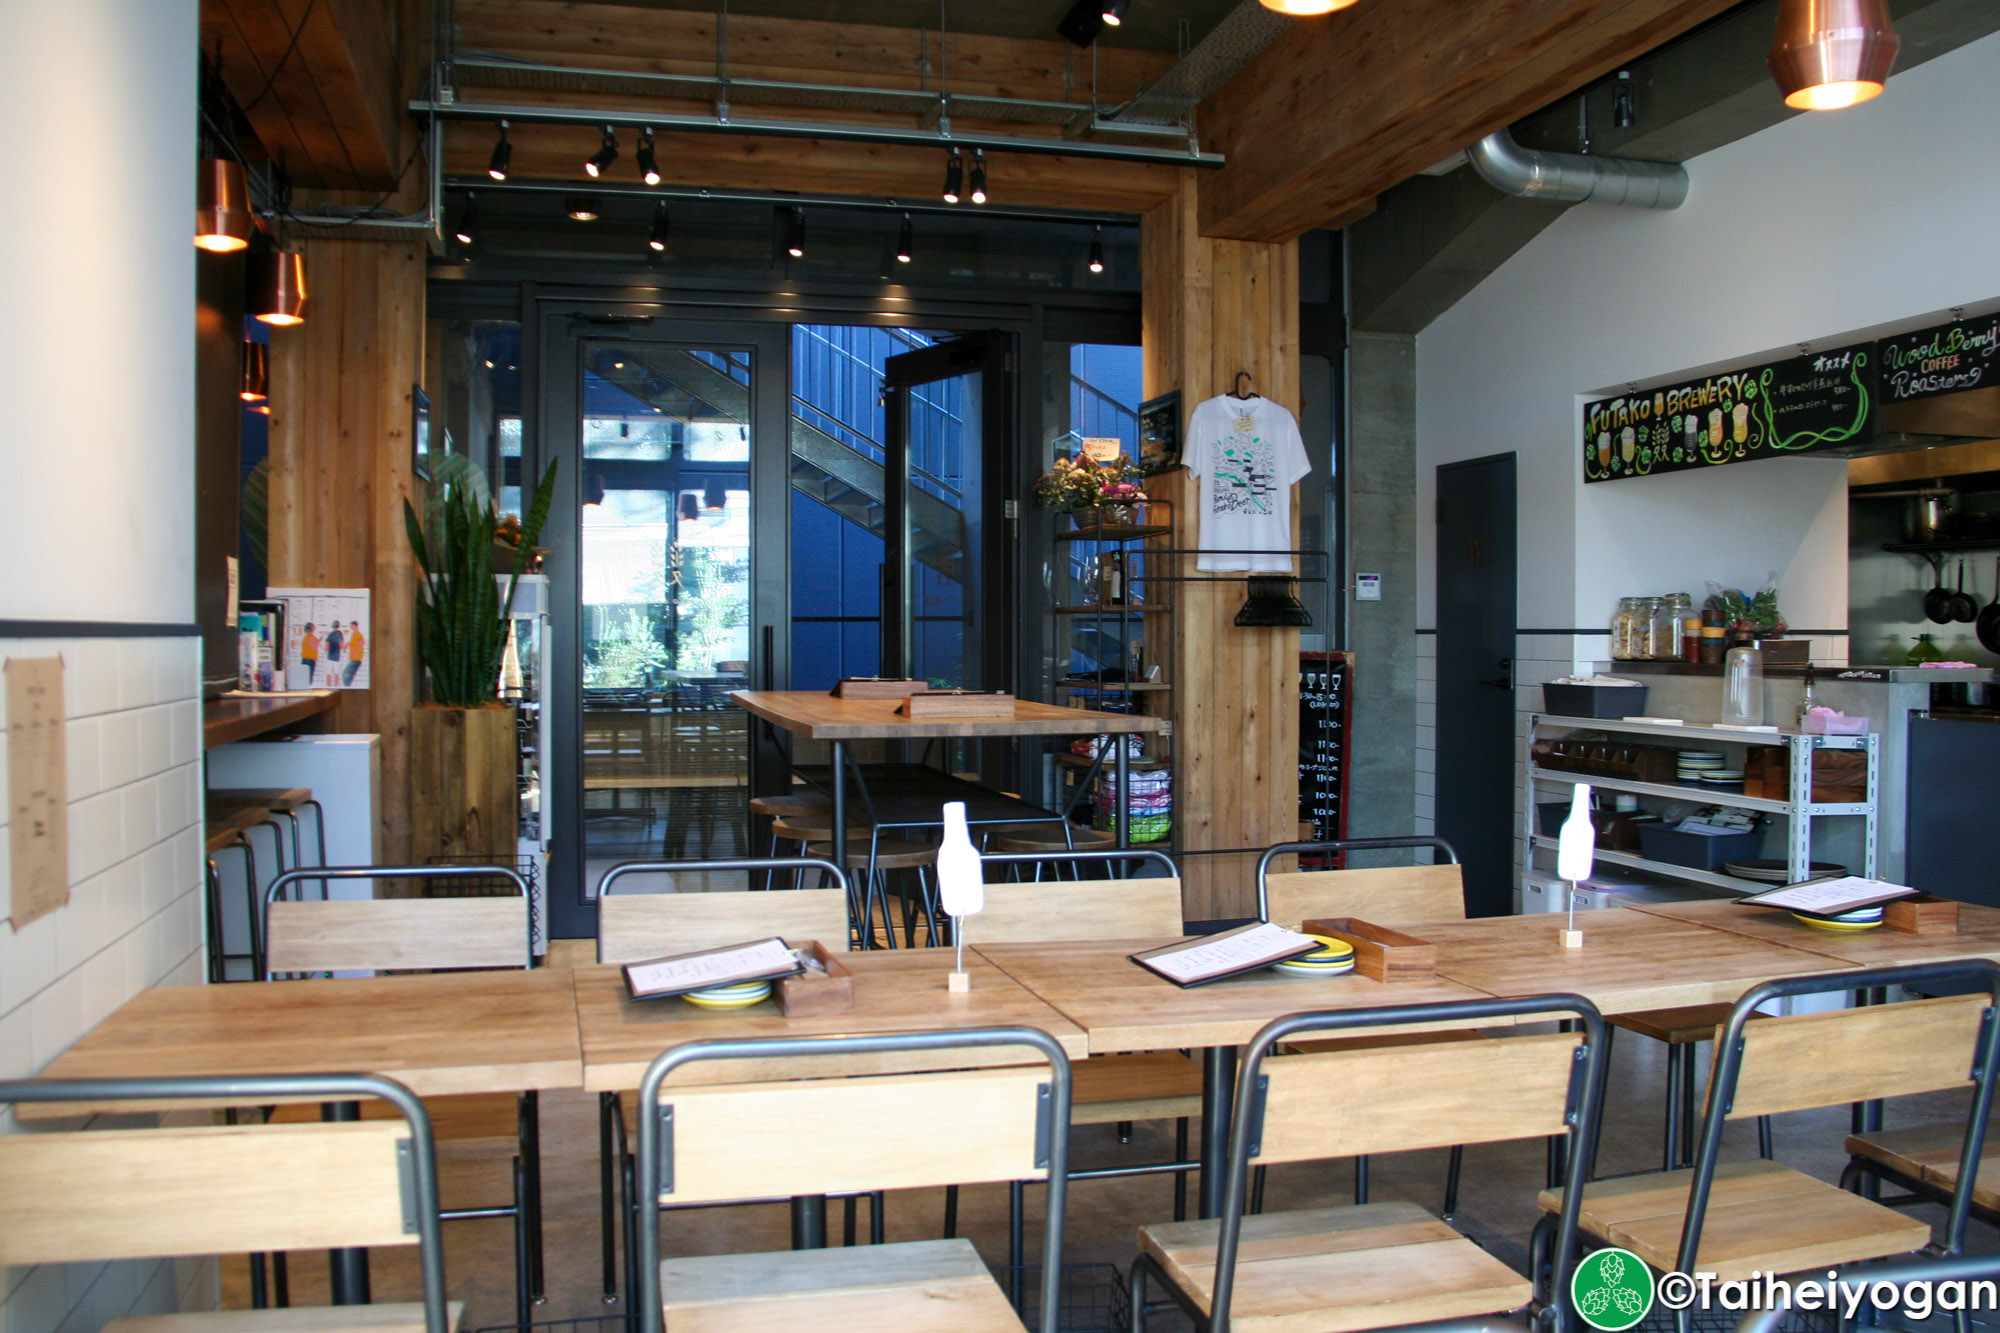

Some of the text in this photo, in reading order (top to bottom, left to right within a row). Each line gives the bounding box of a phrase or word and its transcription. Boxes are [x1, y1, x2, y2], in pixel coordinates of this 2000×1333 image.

[1884, 332, 1945, 369] Wood
[1920, 353, 1961, 374] COFFEE
[1590, 398, 1651, 434] FUTAKO
[1666, 372, 1749, 416] BREWERY
